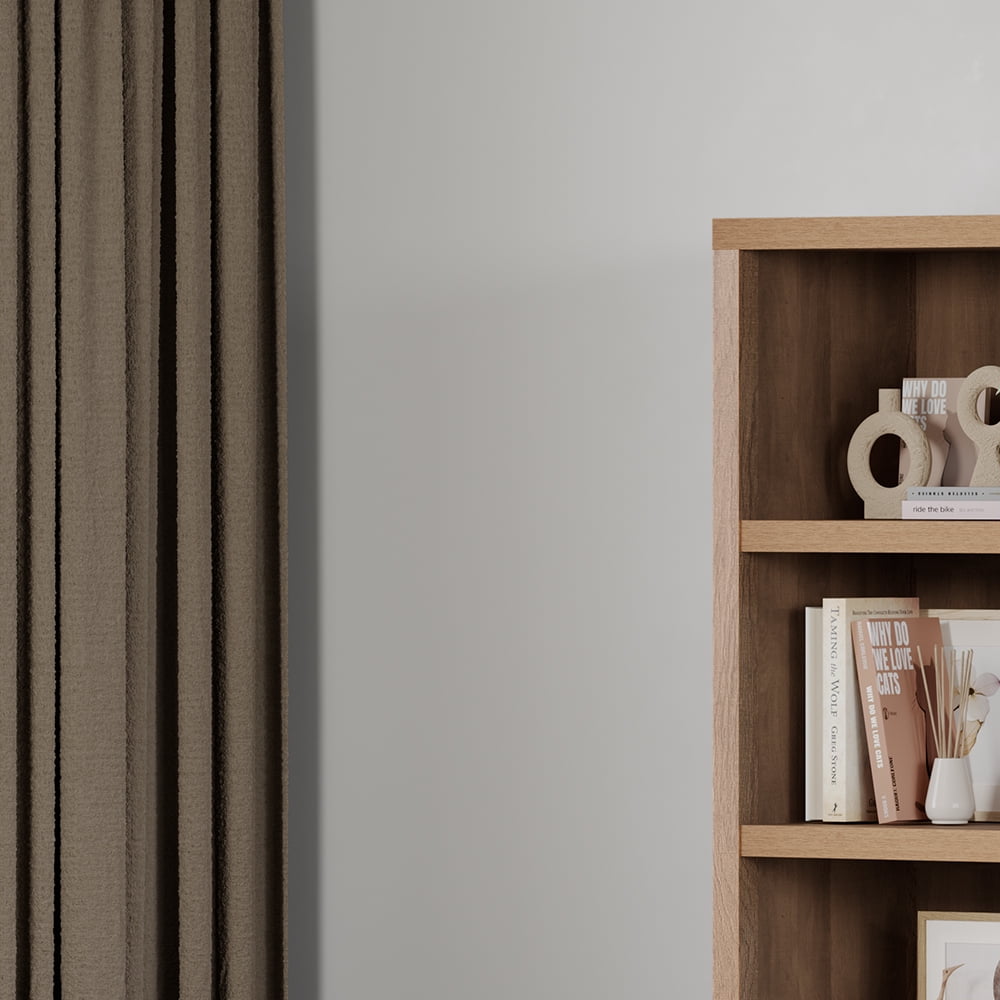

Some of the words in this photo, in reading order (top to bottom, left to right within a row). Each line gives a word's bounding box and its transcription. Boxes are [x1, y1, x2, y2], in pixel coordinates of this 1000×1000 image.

[902, 380, 928, 398] WHY
[931, 380, 947, 398] DO
[902, 398, 918, 415] WE
[921, 398, 947, 415] LOVE
[830, 606, 840, 659] TAMING
[867, 621, 892, 647] WHY
[894, 620, 910, 645] DO
[830, 663, 838, 677] the
[871, 648, 890, 671] WE
[890, 647, 914, 671] LOVE
[876, 672, 901, 696] CATS
[830, 679, 840, 718] WOLF
[868, 705, 876, 715] DO
[870, 717, 878, 729] WE
[830, 725, 839, 753] GREG
[872, 730, 880, 748] LOVE
[874, 749, 883, 769] CATS
[830, 755, 839, 786] STONE
